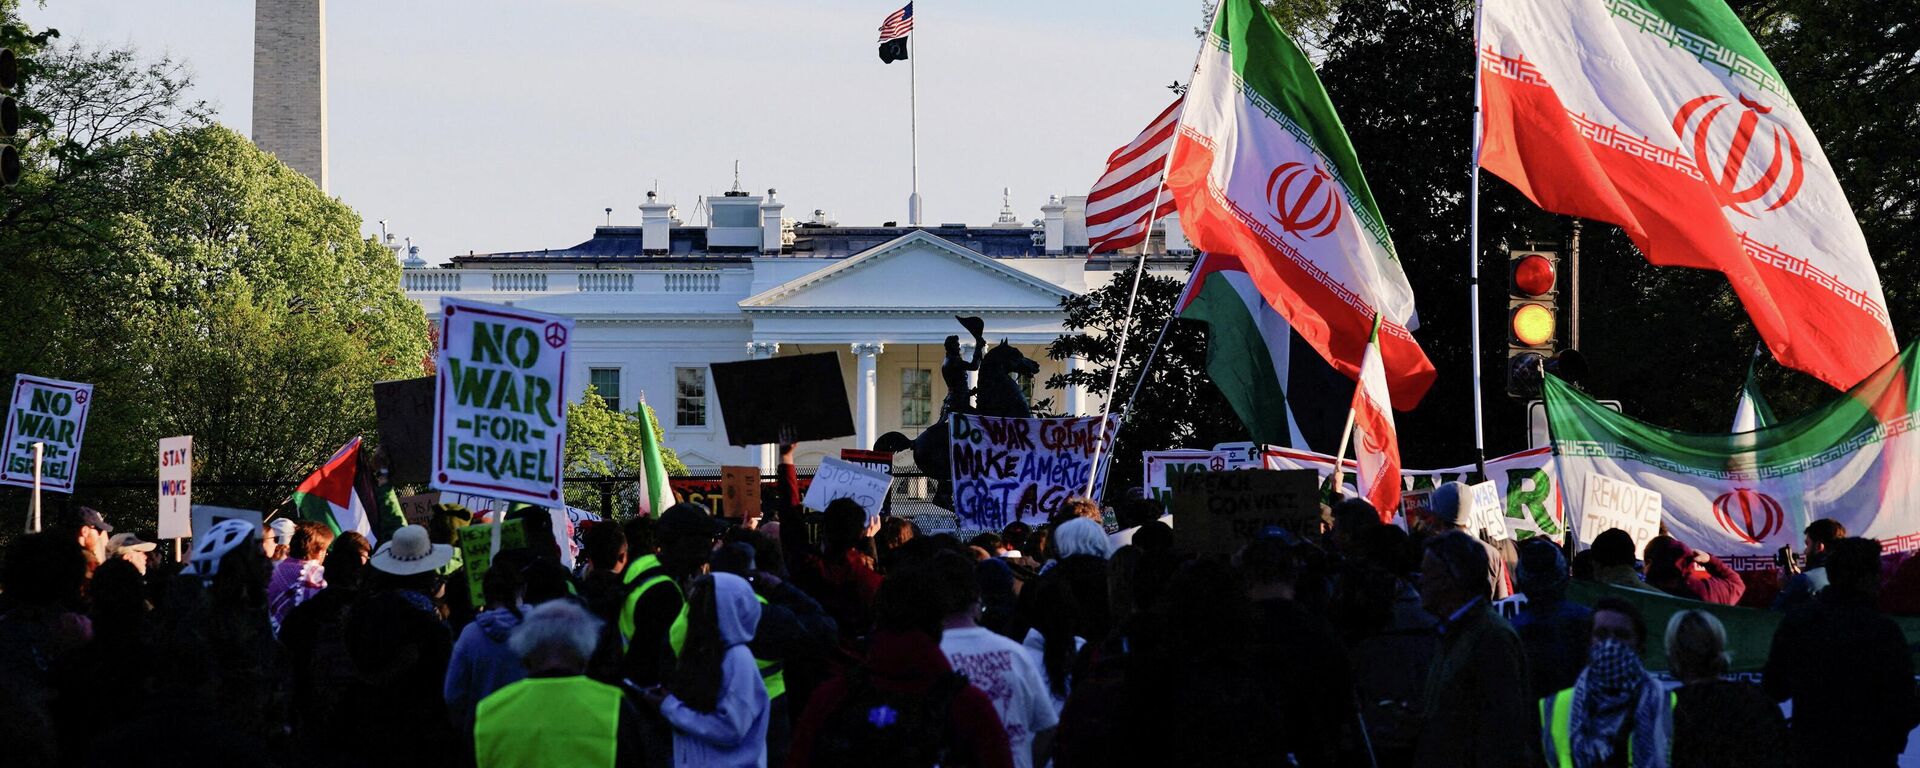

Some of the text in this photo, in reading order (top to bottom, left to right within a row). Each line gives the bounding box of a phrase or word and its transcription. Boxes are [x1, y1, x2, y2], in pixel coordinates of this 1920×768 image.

[471, 320, 539, 369] NO
[30, 387, 72, 416] NO
[448, 357, 557, 427] WAR
[16, 408, 76, 448] WAR
[979, 416, 1035, 451] WAR
[162, 448, 187, 467] STAY
[447, 435, 554, 484] ISRAEL
[820, 464, 864, 486] STOP
[953, 443, 1019, 480] MAKE
[161, 479, 187, 496] WOKE
[1406, 498, 1430, 511] IRAN
[1471, 485, 1498, 507] WAR
[1590, 475, 1659, 525] REMOVE
